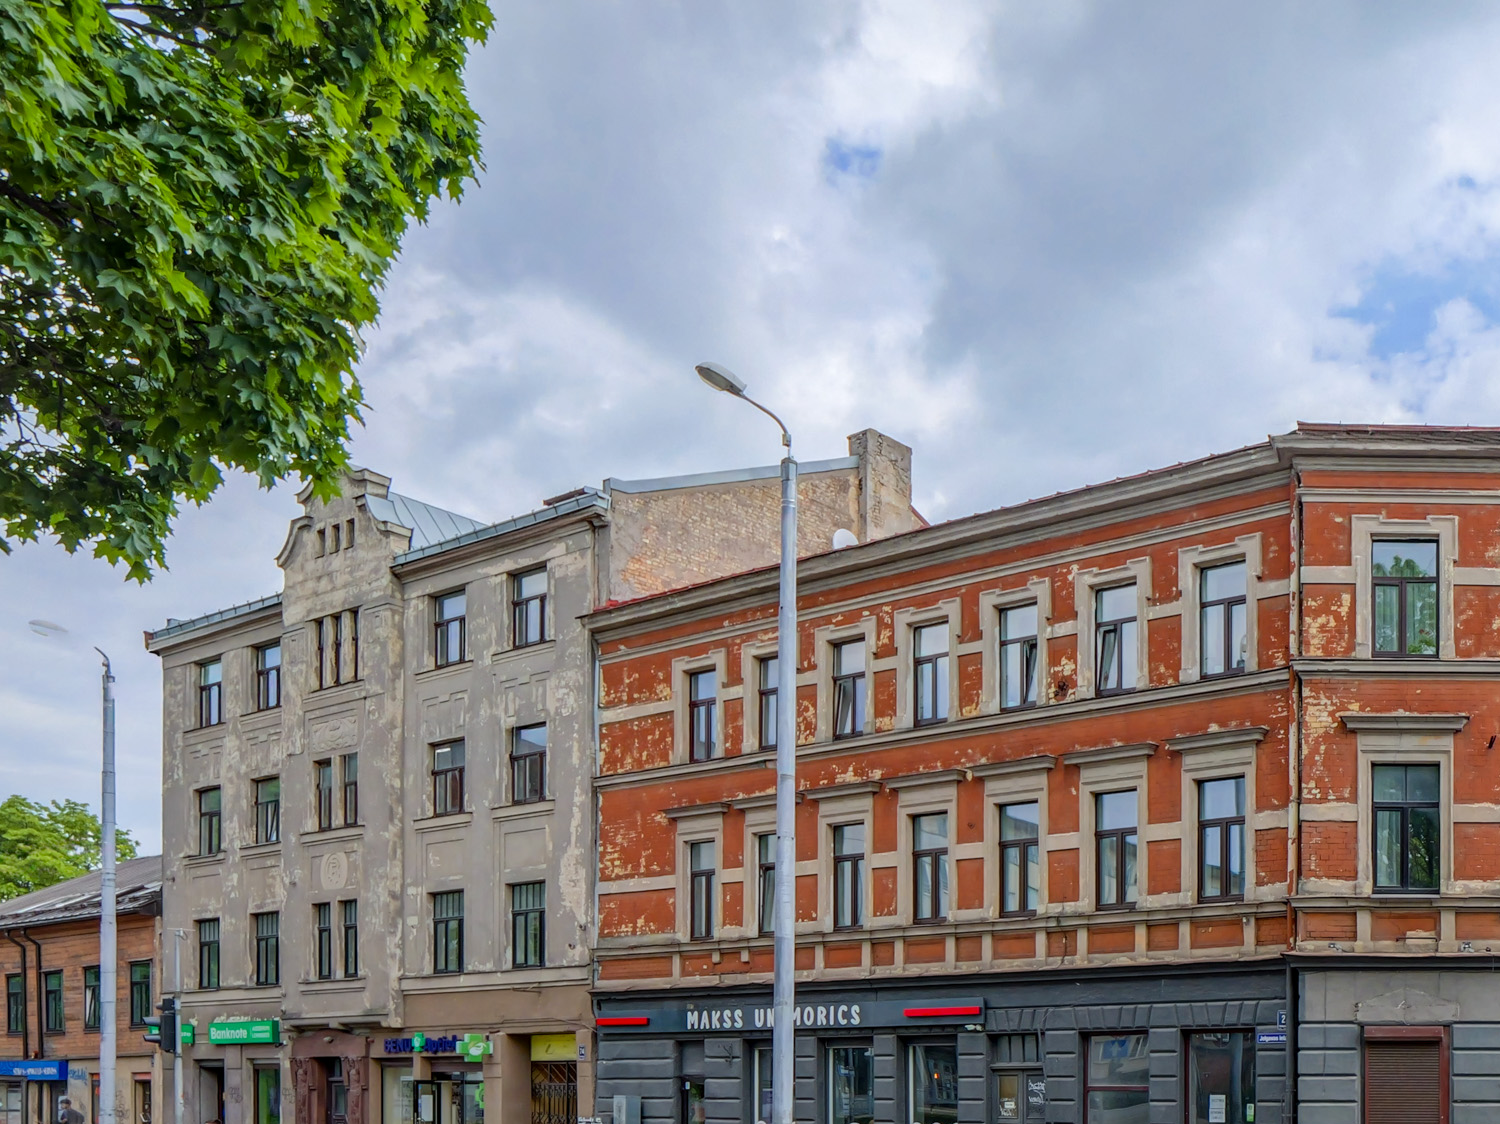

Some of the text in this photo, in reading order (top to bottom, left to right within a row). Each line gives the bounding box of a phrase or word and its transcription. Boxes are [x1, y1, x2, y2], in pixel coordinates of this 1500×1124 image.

[686, 1008, 744, 1030] MAKSS
[792, 1004, 861, 1026] MORICS
[210, 1027, 248, 1040] Banknote
[383, 1038, 413, 1053] BENU
